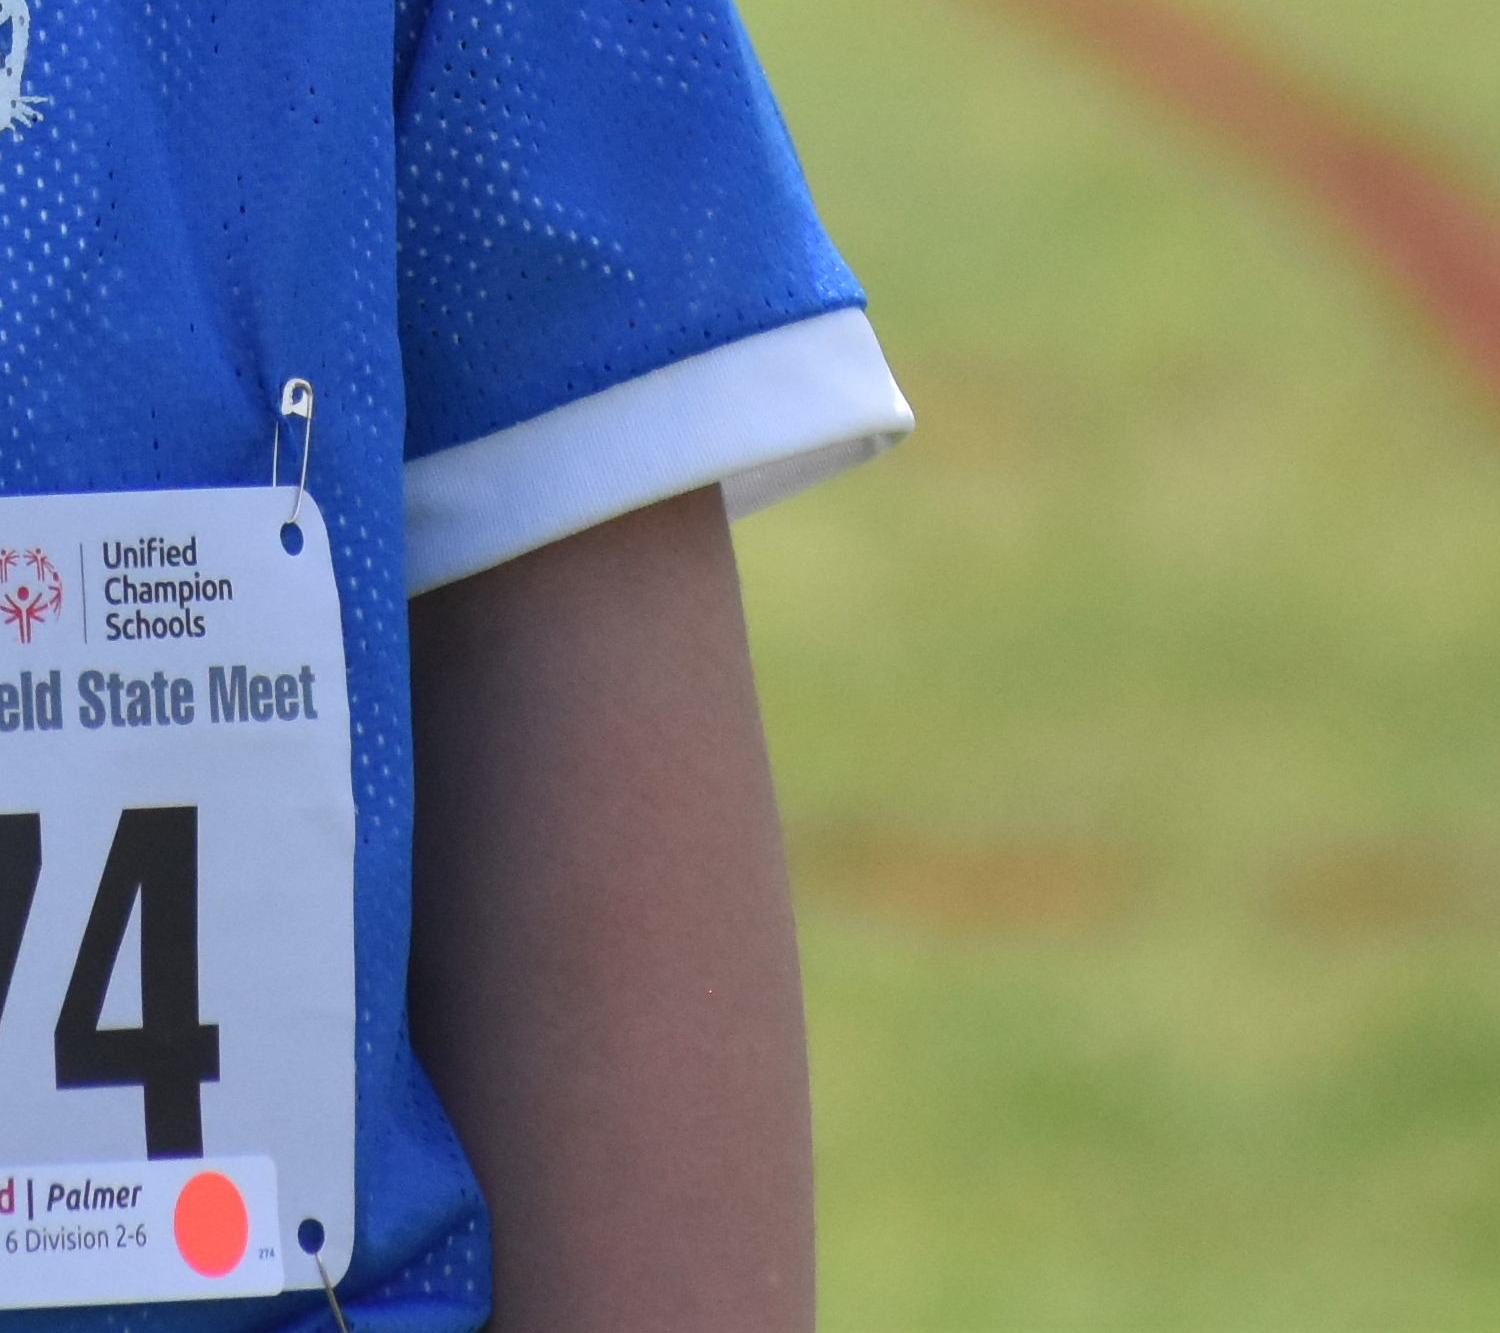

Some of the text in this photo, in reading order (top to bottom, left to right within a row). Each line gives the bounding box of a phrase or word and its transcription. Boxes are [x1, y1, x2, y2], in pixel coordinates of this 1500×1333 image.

[102, 536, 198, 570] Unified
[104, 571, 234, 609] Champion
[105, 607, 207, 642] Schools
[77, 668, 196, 731] State
[208, 664, 319, 724] Meet
[46, 1179, 143, 1213] Palmer
[5, 1228, 19, 1255] 6
[25, 1224, 110, 1253] Division
[115, 1223, 148, 1249] 2-6
[258, 1247, 275, 1260] 274
